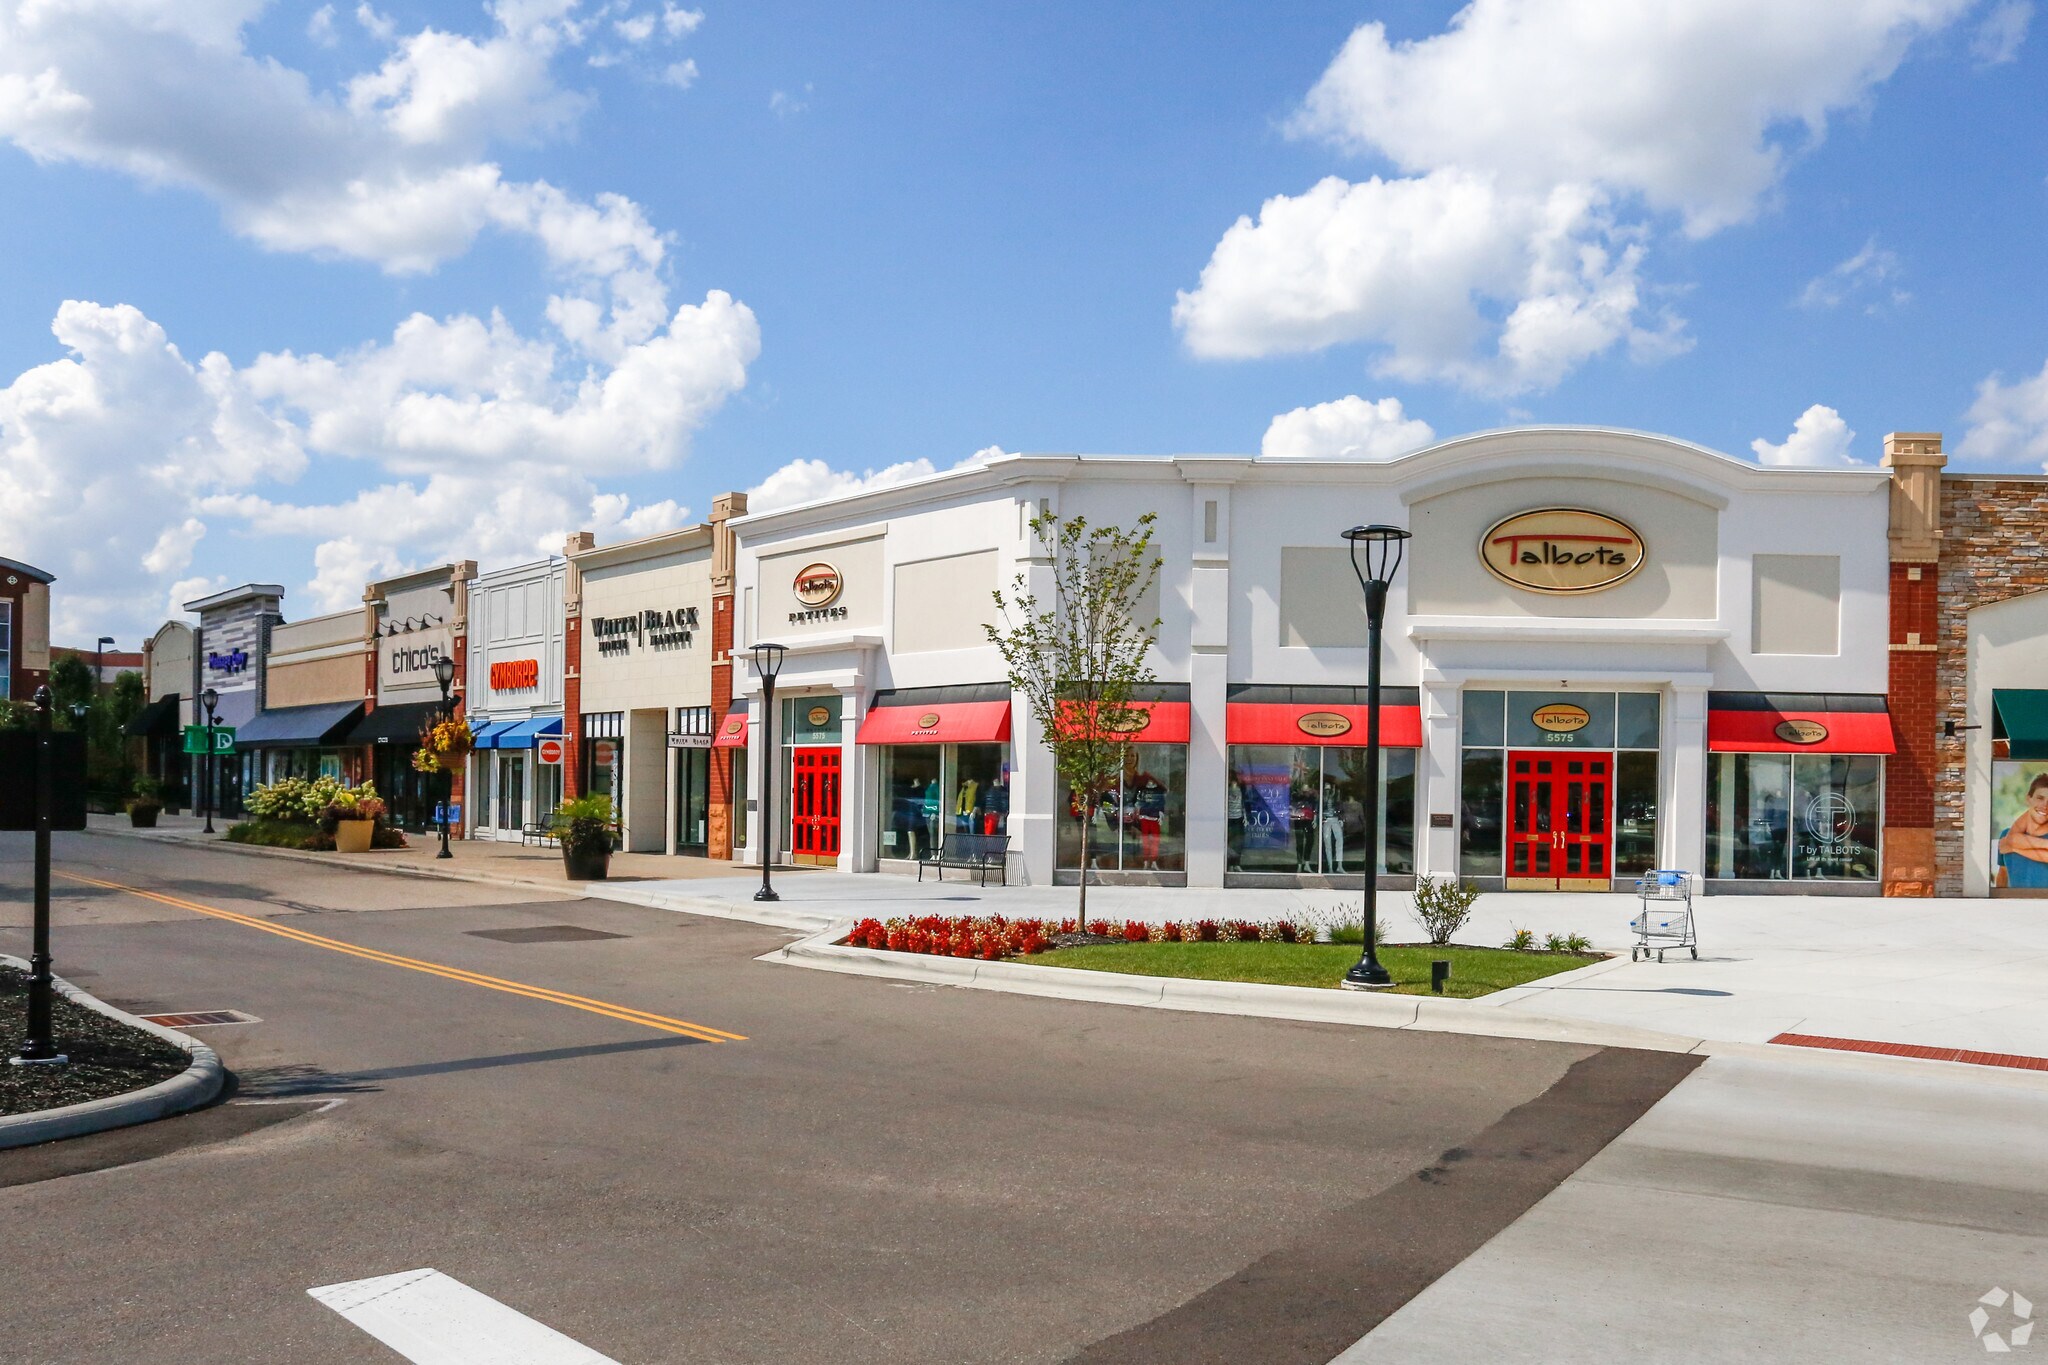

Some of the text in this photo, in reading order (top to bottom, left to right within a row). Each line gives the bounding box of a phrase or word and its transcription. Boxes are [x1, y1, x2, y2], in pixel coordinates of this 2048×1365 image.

[1492, 534, 1633, 565] Talbots
[796, 573, 837, 593] Talbots
[591, 606, 698, 637] WHITE BLACK
[788, 606, 847, 622] PETITES
[392, 645, 439, 673] chico's
[1535, 712, 1586, 724] Talbots
[812, 732, 826, 740] 5575
[1547, 733, 1574, 743] 5575
[1799, 845, 1860, 855] T by TALBOTS
